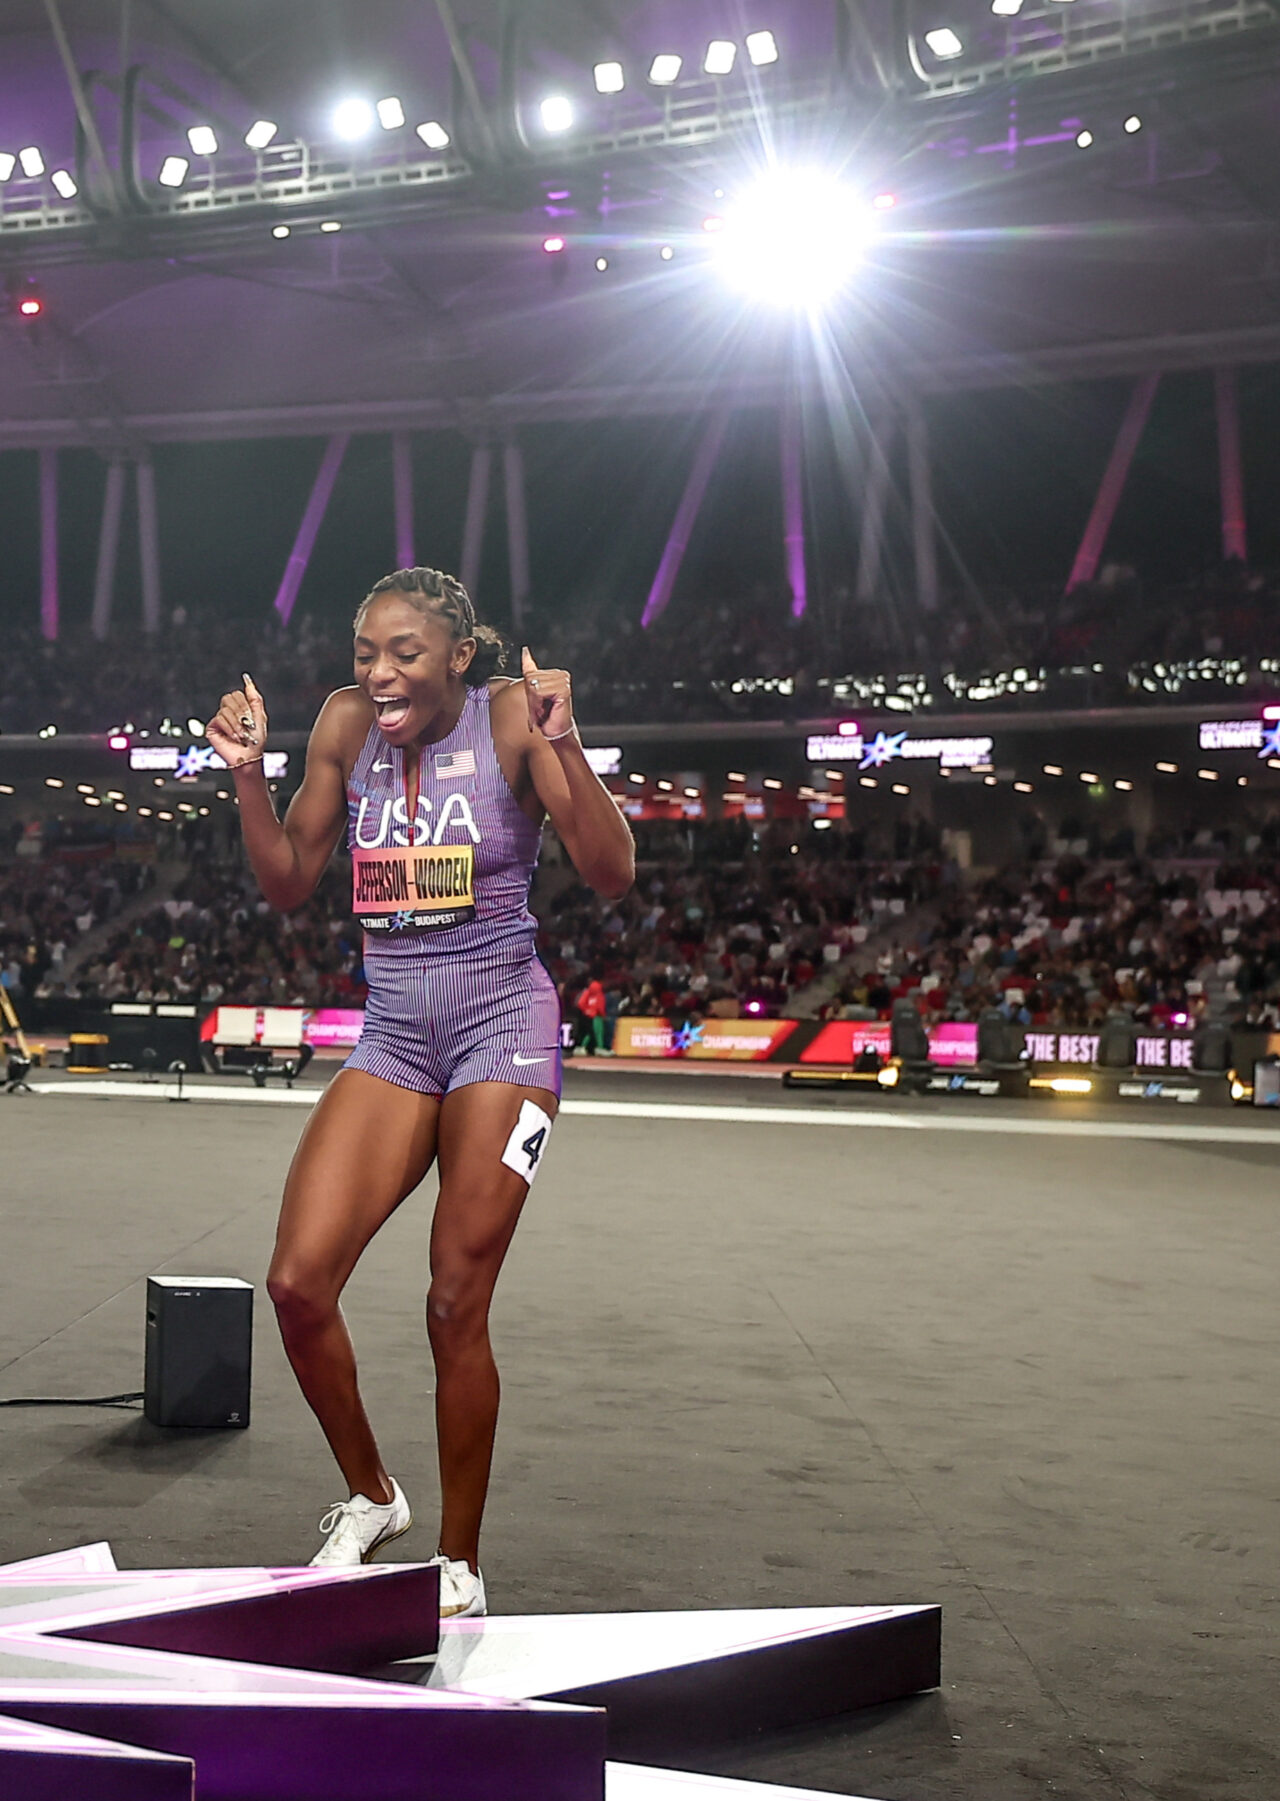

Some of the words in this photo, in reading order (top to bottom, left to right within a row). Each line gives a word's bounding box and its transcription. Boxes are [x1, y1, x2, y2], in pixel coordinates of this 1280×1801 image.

[356, 793, 482, 849] USA
[356, 857, 469, 902] JEFFERSON-WOODEN
[414, 913, 456, 926] BUDAPEST
[1024, 1033, 1056, 1061] THE
[1059, 1035, 1100, 1063] BEST
[1136, 1037, 1167, 1066] THE
[1170, 1039, 1193, 1067] BE
[521, 1126, 546, 1170] 4
